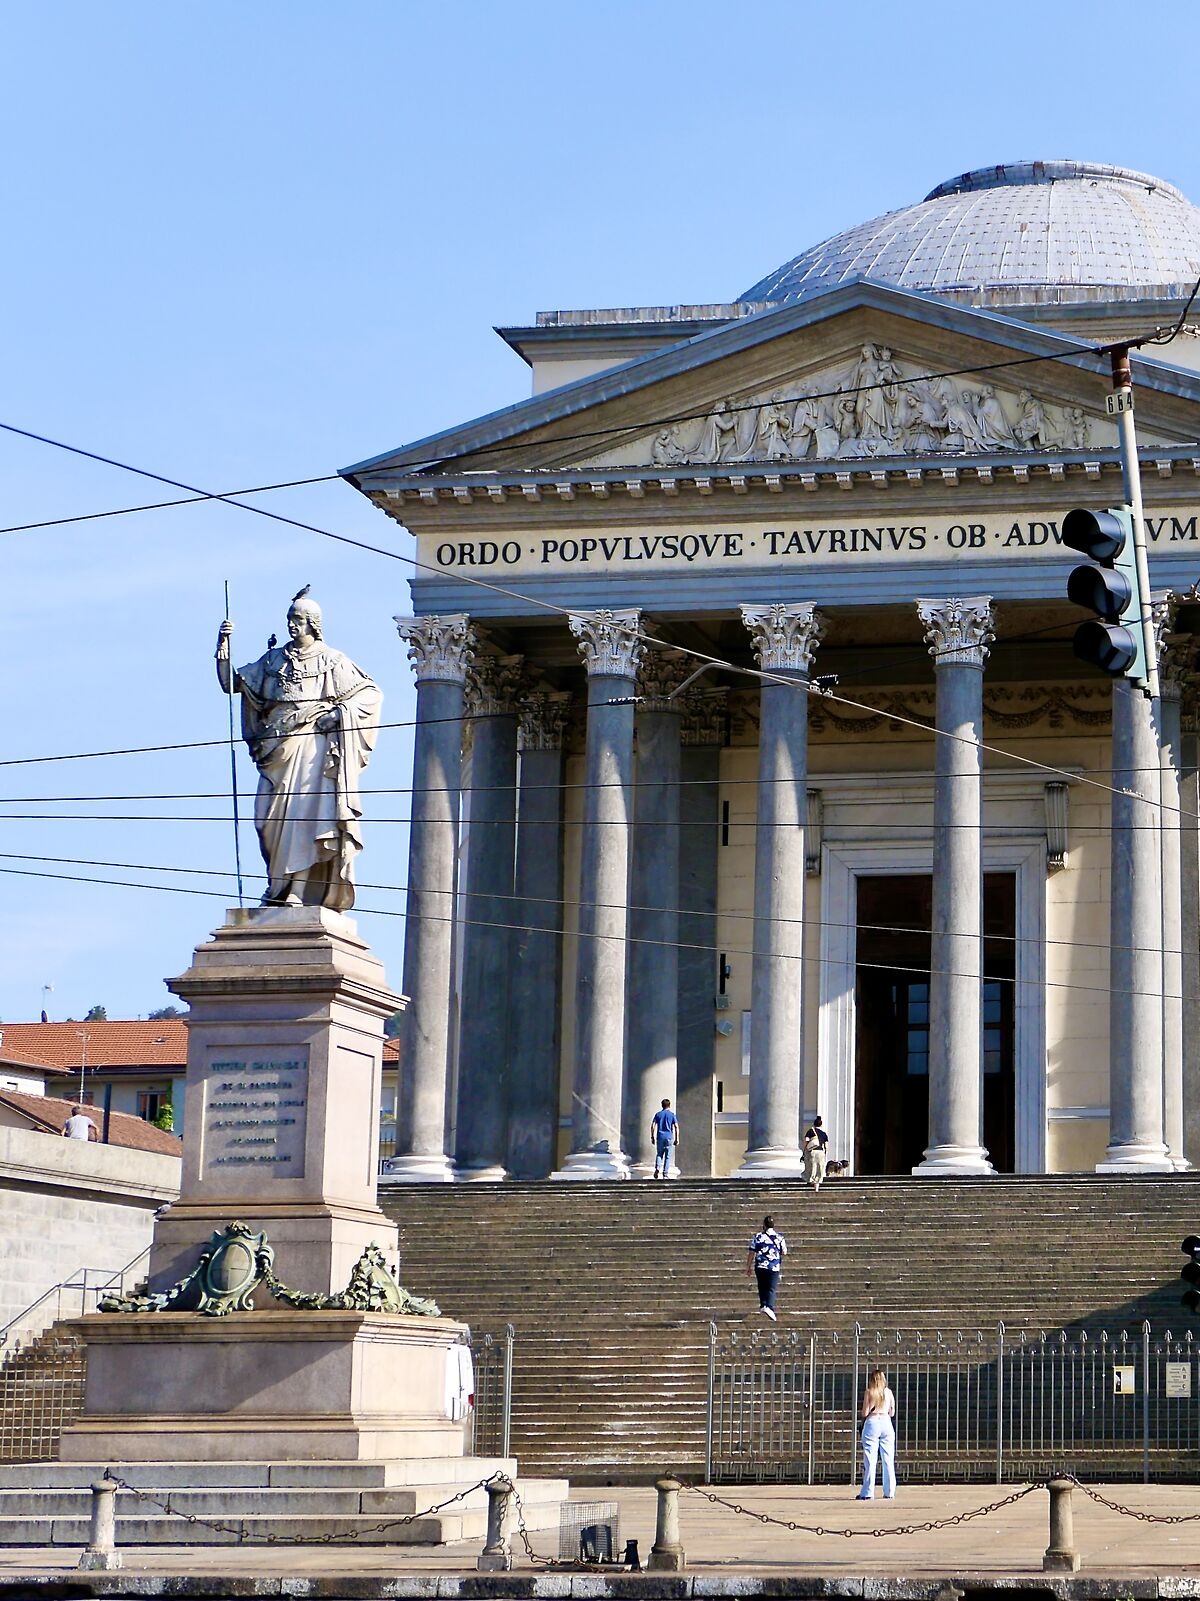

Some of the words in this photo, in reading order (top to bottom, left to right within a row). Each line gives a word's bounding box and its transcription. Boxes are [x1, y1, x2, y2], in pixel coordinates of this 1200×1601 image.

[436, 541, 521, 565] ORDO
[541, 533, 744, 563] POPVLVSQVE
[763, 526, 927, 555] TAVRINVS
[946, 524, 986, 548] OB
[1002, 516, 1199, 547] ADVVM
